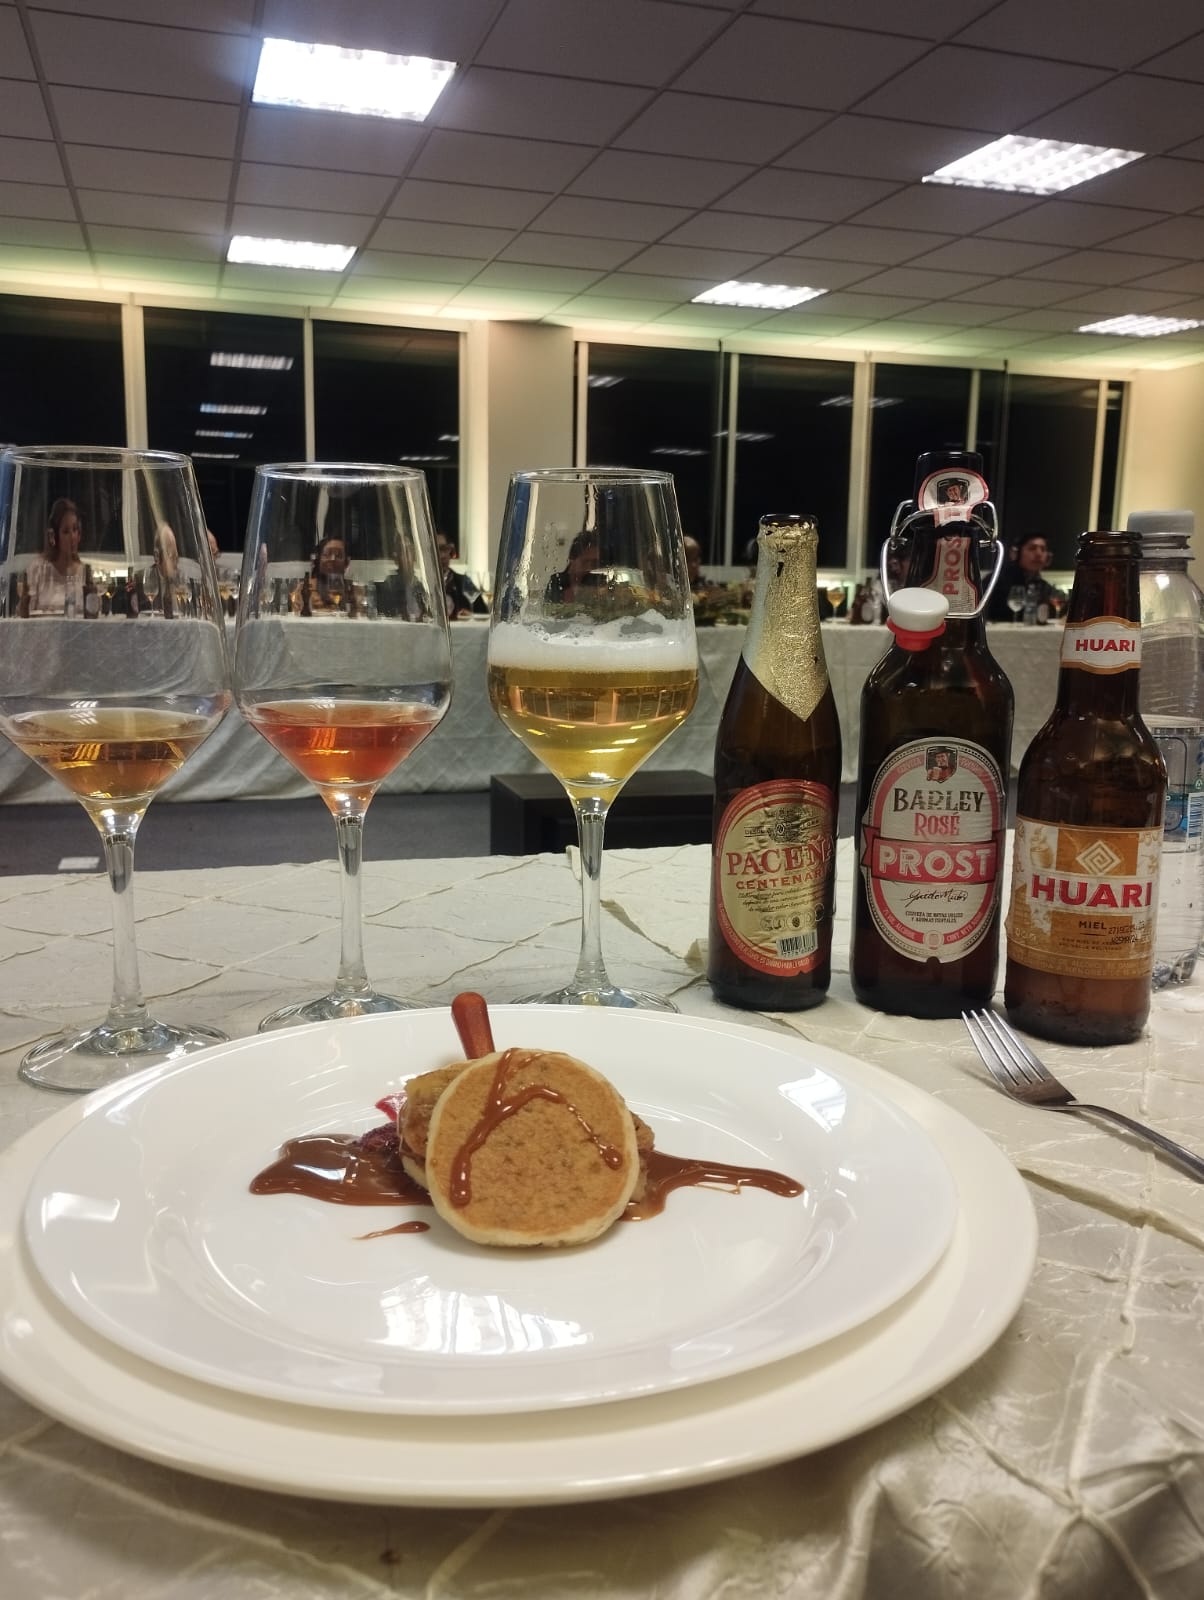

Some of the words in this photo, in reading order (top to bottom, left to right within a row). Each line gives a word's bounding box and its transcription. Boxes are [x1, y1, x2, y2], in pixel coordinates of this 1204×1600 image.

[1075, 638, 1135, 653] HUARI
[893, 787, 985, 812] BARLEY
[914, 812, 961, 840] ROSÉ
[878, 844, 992, 879] PROST
[1032, 873, 1152, 908] HUARI
[1078, 920, 1107, 930] MIEL
